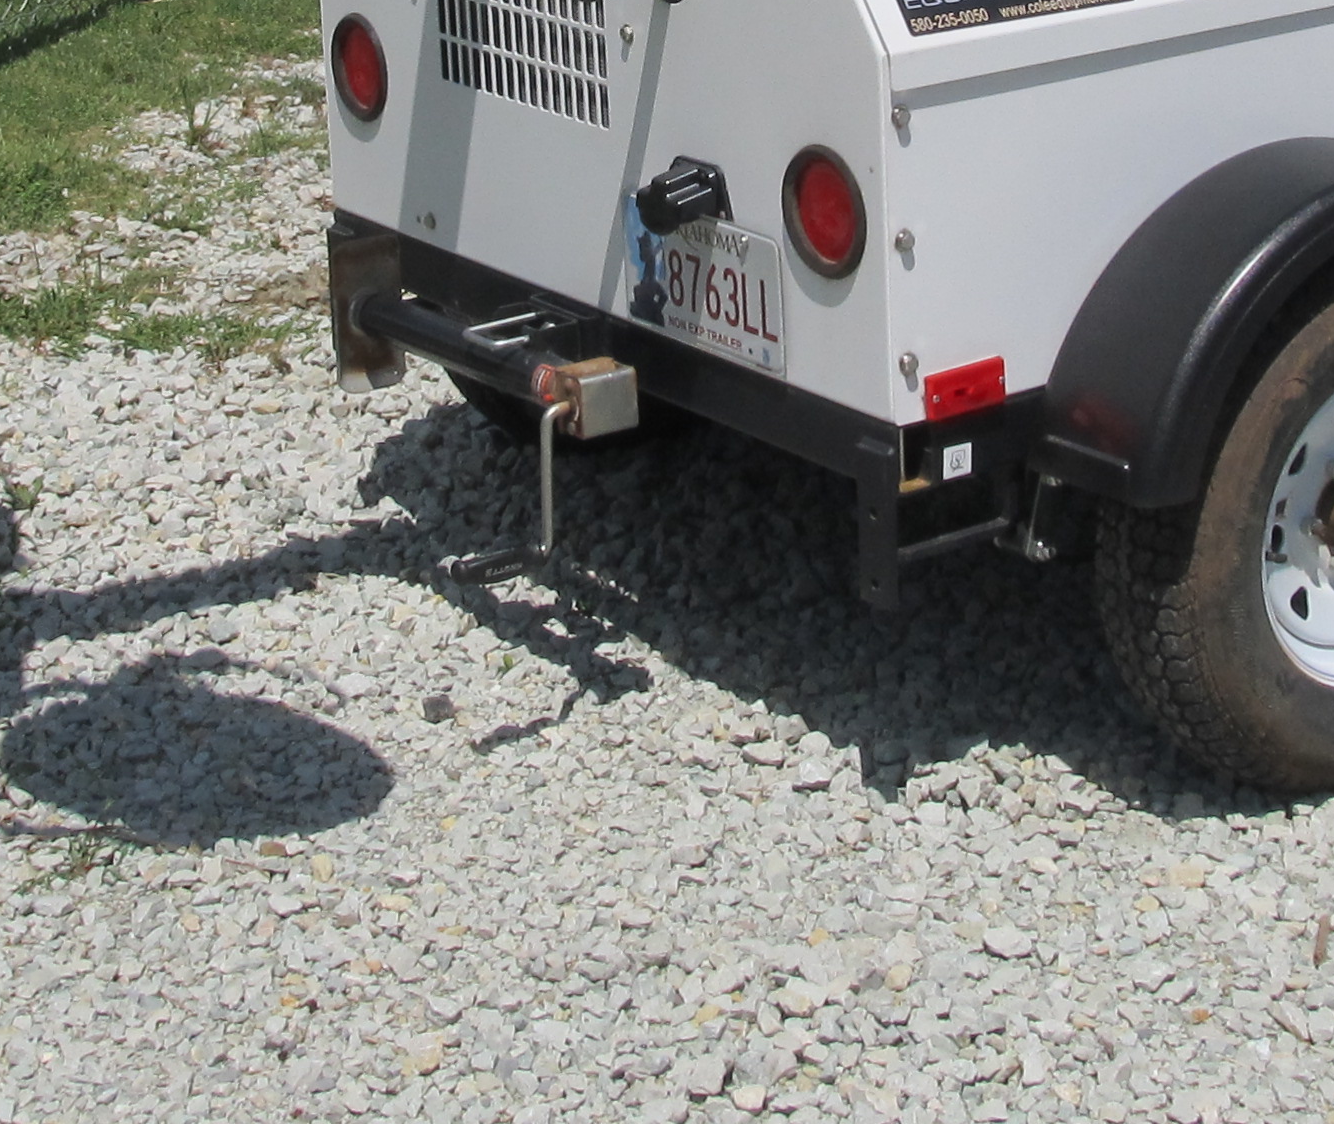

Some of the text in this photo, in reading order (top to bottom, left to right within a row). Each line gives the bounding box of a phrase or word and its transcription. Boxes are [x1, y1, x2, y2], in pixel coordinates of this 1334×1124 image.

[910, 7, 989, 33] 580-235-0050
[668, 249, 779, 343] 8763LL
[707, 329, 743, 351] TRAILER
